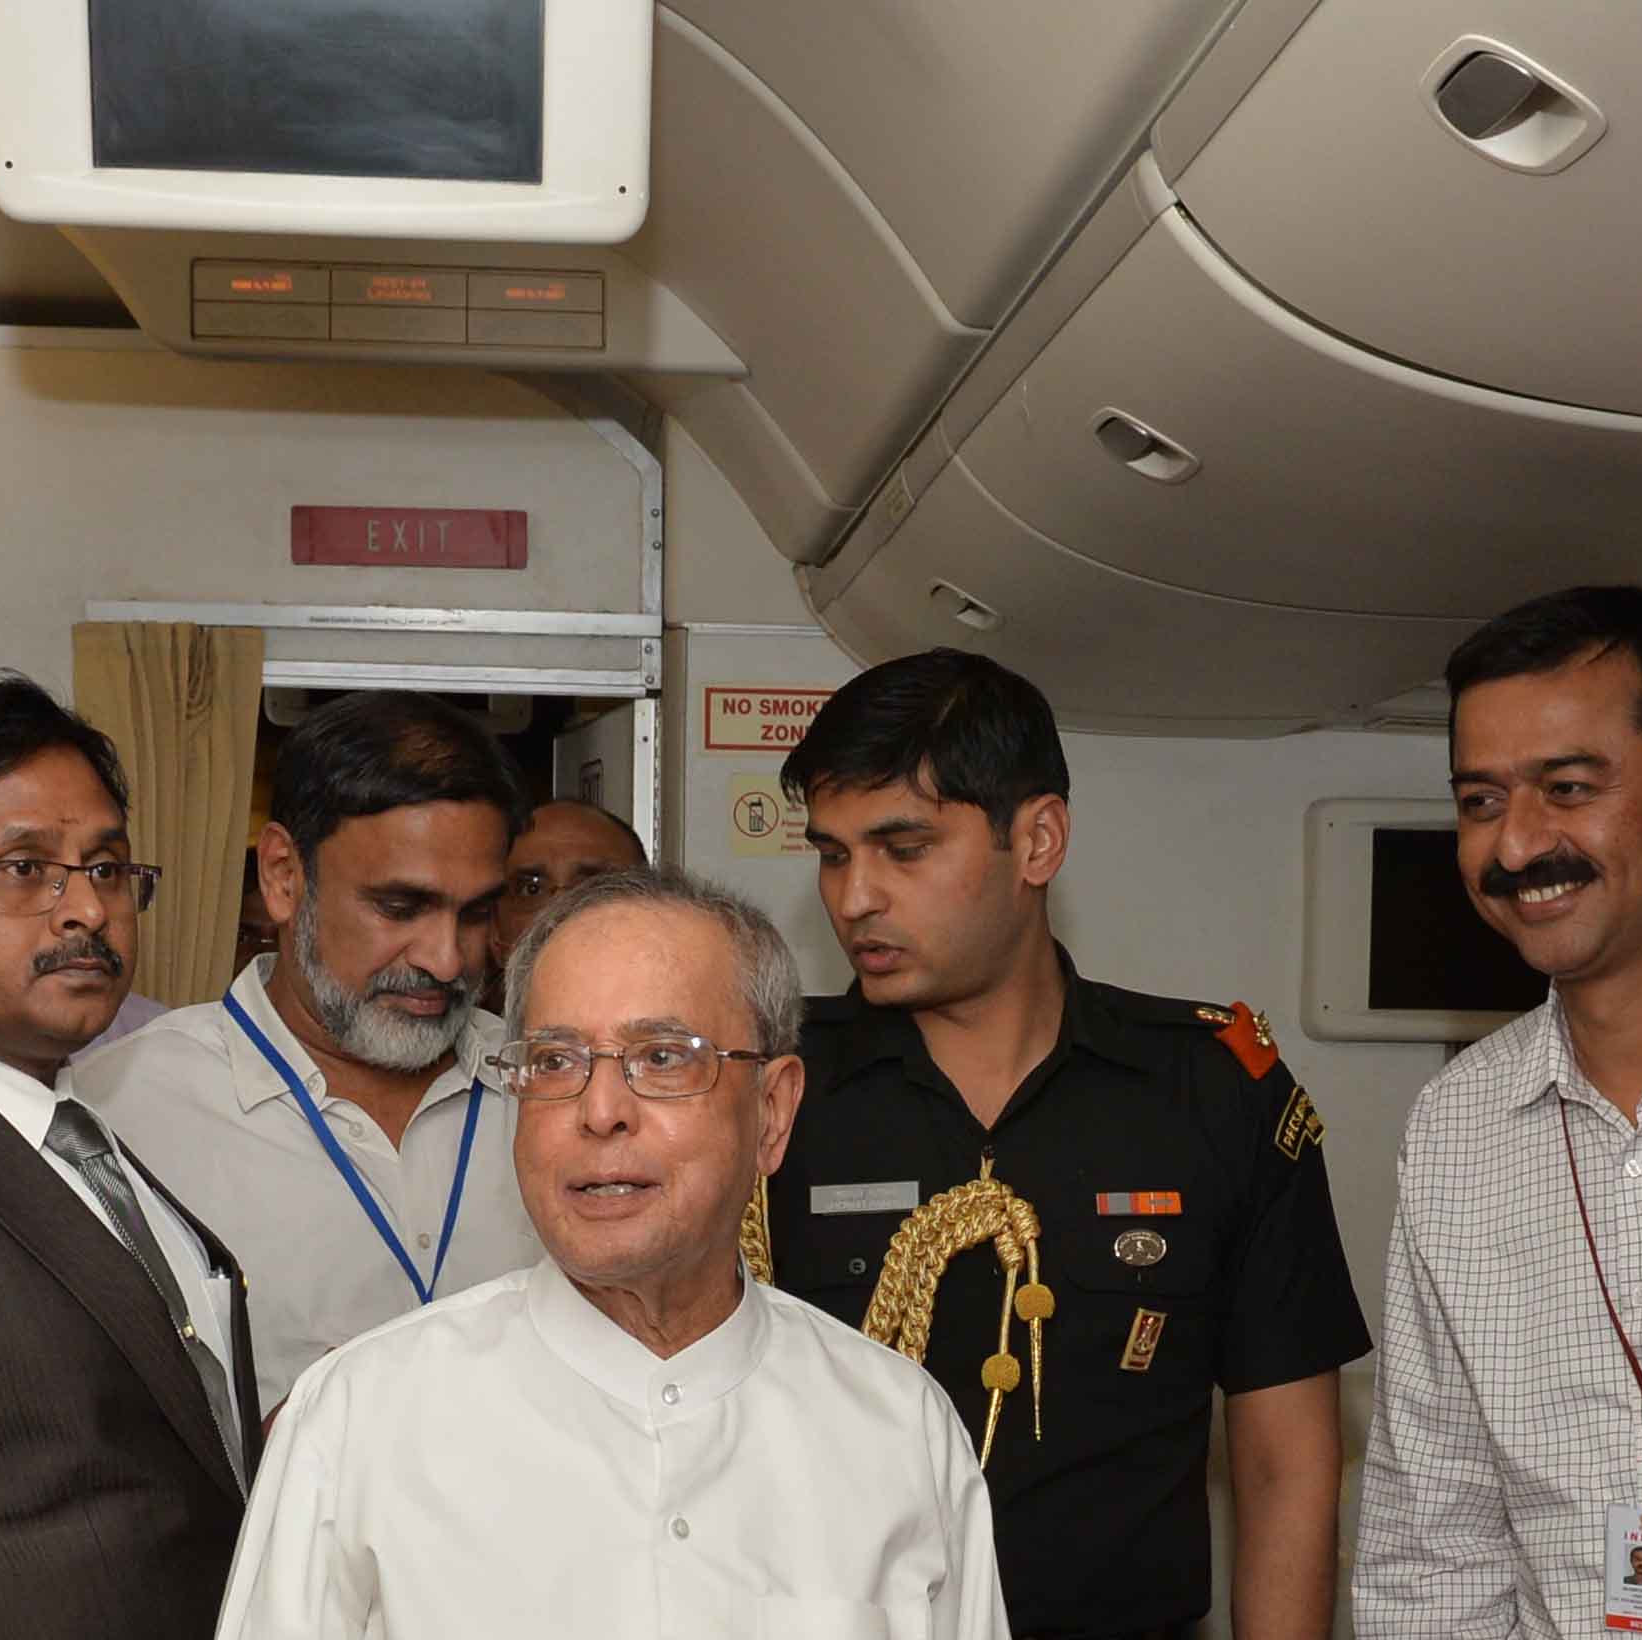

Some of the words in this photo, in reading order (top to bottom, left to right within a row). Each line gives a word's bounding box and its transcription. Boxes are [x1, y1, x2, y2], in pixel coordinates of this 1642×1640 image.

[365, 519, 453, 553] EXIT
[723, 698, 752, 715] NO
[759, 698, 819, 717] SMOK
[761, 724, 806, 742] ZON
